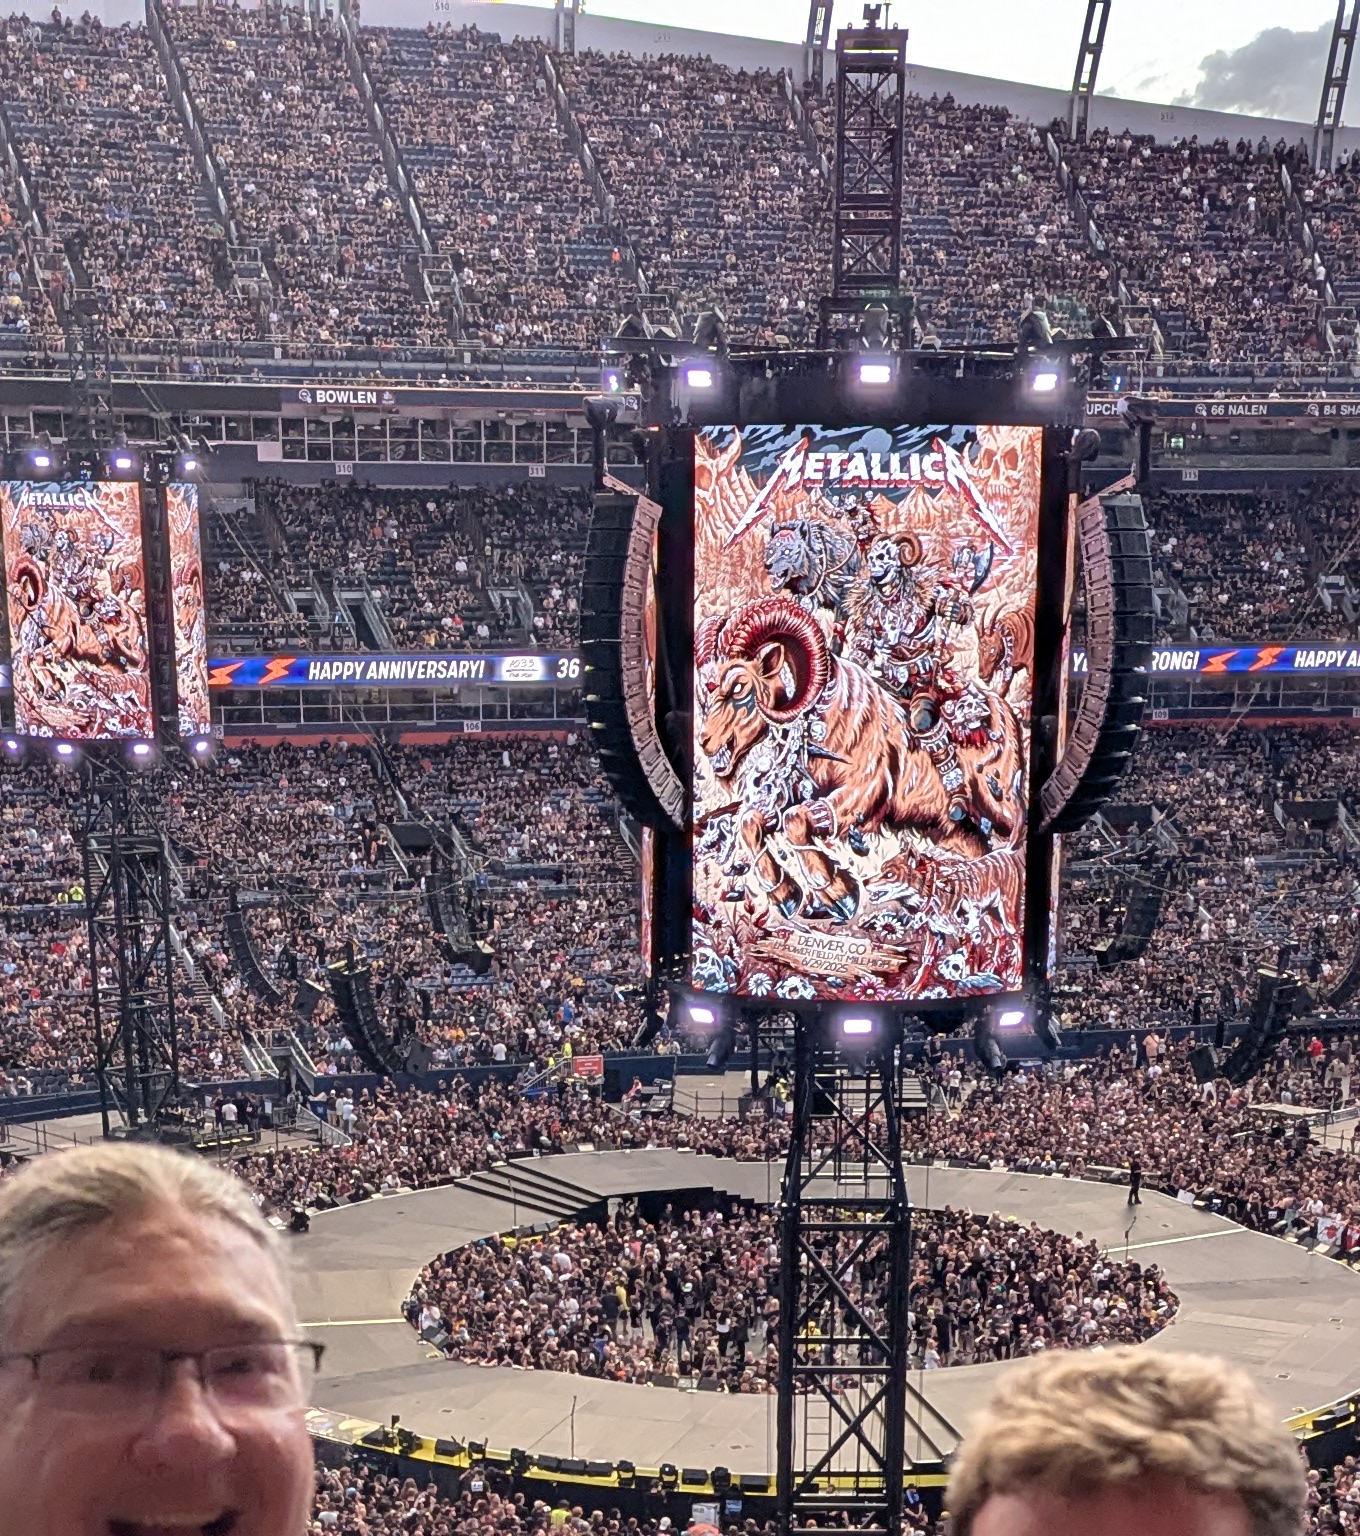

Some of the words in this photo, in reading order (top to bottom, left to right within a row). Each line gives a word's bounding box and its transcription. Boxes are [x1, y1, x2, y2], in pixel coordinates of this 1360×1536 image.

[316, 389, 377, 404] BOWLEN
[1211, 404, 1225, 415] 66
[1228, 404, 1267, 415] NALEN
[1323, 405, 1337, 415] 84
[1294, 650, 1346, 668] HAPPY
[308, 662, 365, 680] HAPPY
[366, 660, 484, 679] ANNIVERSARY!
[556, 658, 580, 679] 36
[465, 722, 480, 731] 106
[848, 943, 867, 955] CO
[833, 954, 844, 962] AT
[801, 956, 848, 974] 6/29/2025
